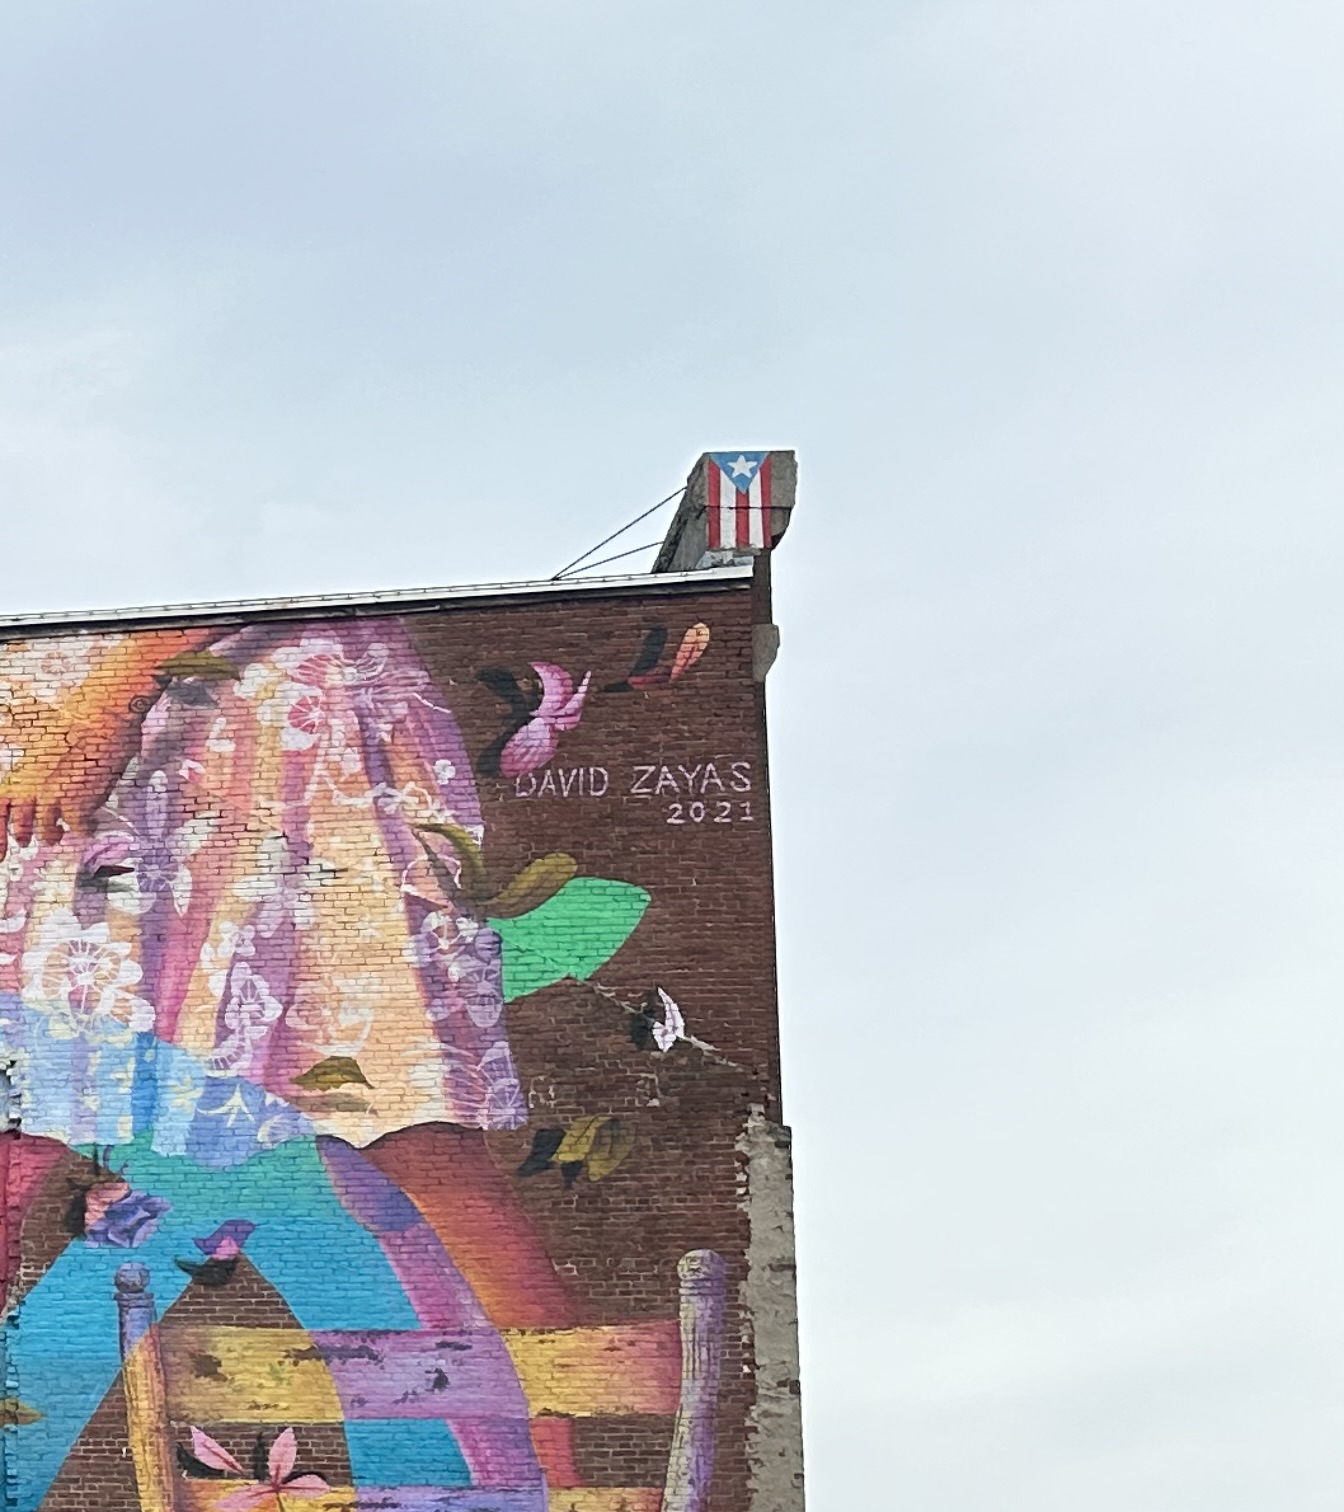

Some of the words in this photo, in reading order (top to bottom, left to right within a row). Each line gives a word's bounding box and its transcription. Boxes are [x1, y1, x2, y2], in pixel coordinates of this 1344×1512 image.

[515, 766, 609, 797] DAVID
[630, 762, 752, 795] ZAYAS
[666, 801, 754, 824] 2021
